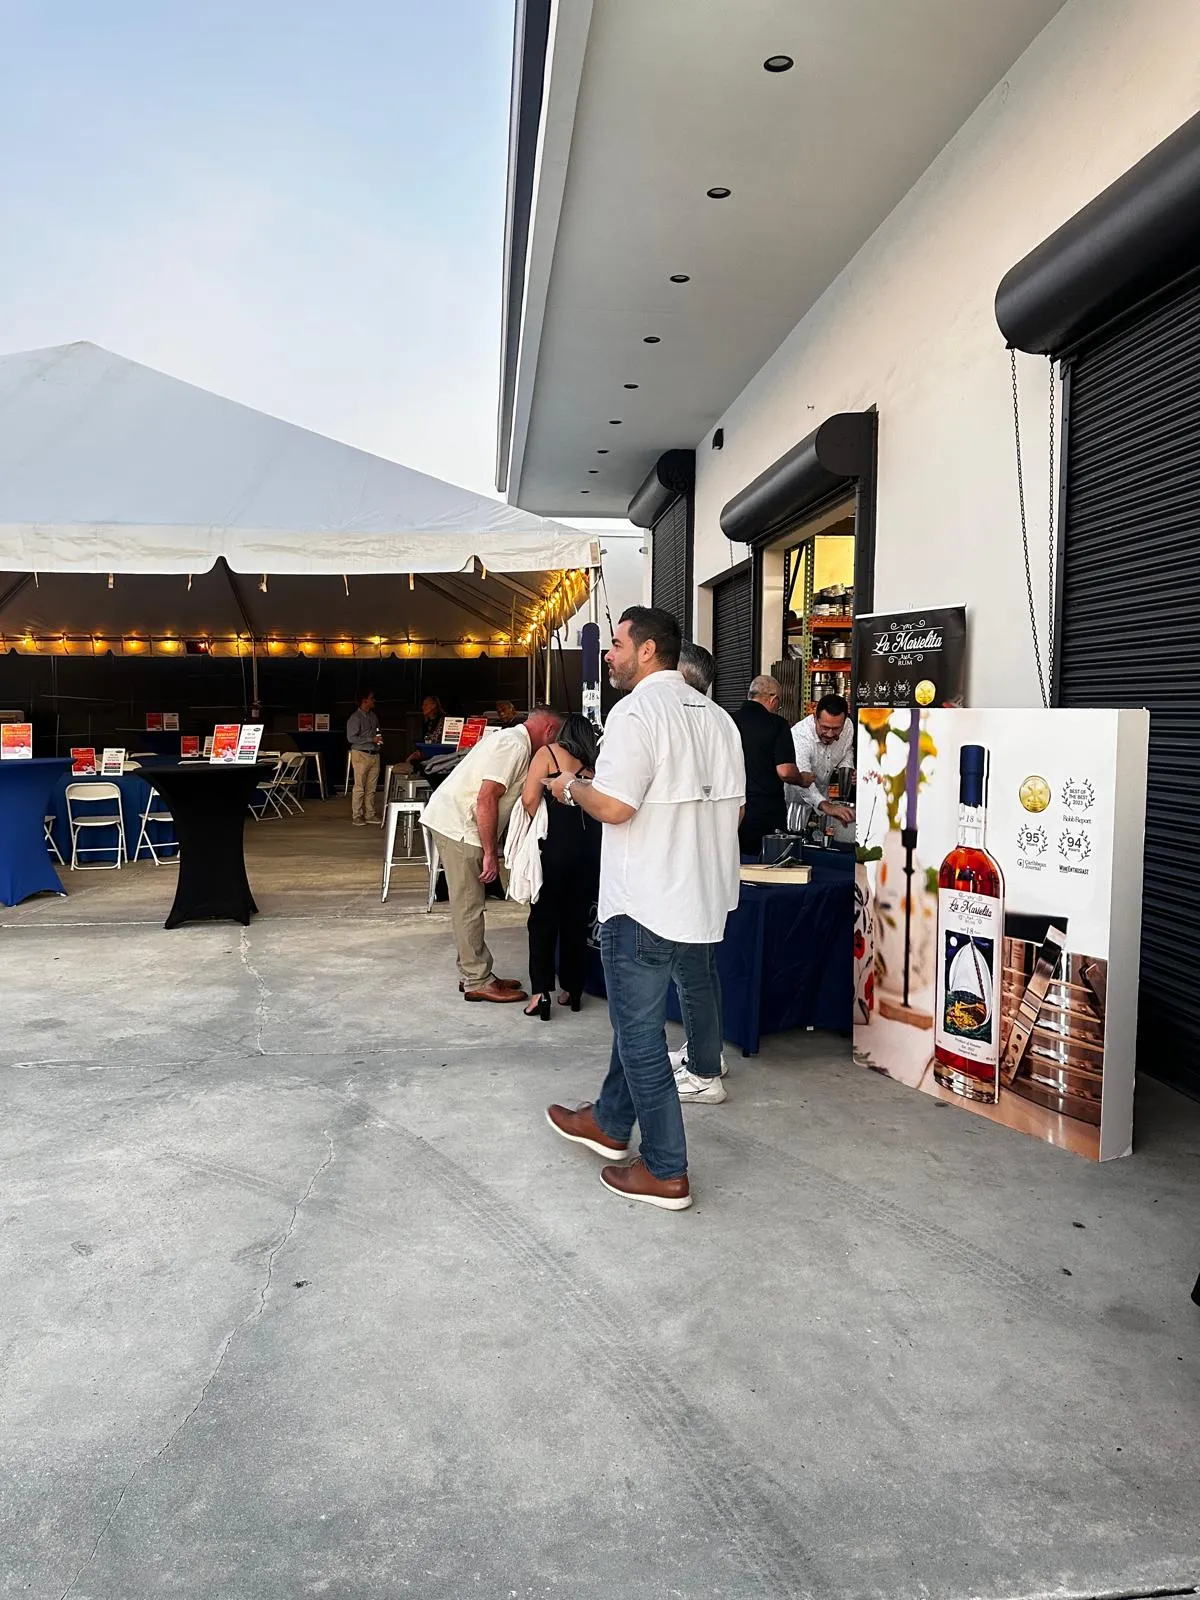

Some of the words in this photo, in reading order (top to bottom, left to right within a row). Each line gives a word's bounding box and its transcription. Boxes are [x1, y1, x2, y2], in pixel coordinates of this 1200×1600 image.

[874, 633, 890, 654] La
[891, 630, 942, 652] Marielita
[966, 814, 975, 823] 18
[1025, 832, 1039, 843] 95
[1067, 836, 1082, 849] 94
[949, 898, 959, 913] La
[960, 899, 993, 918] Marielita
[966, 927, 974, 935] 18
